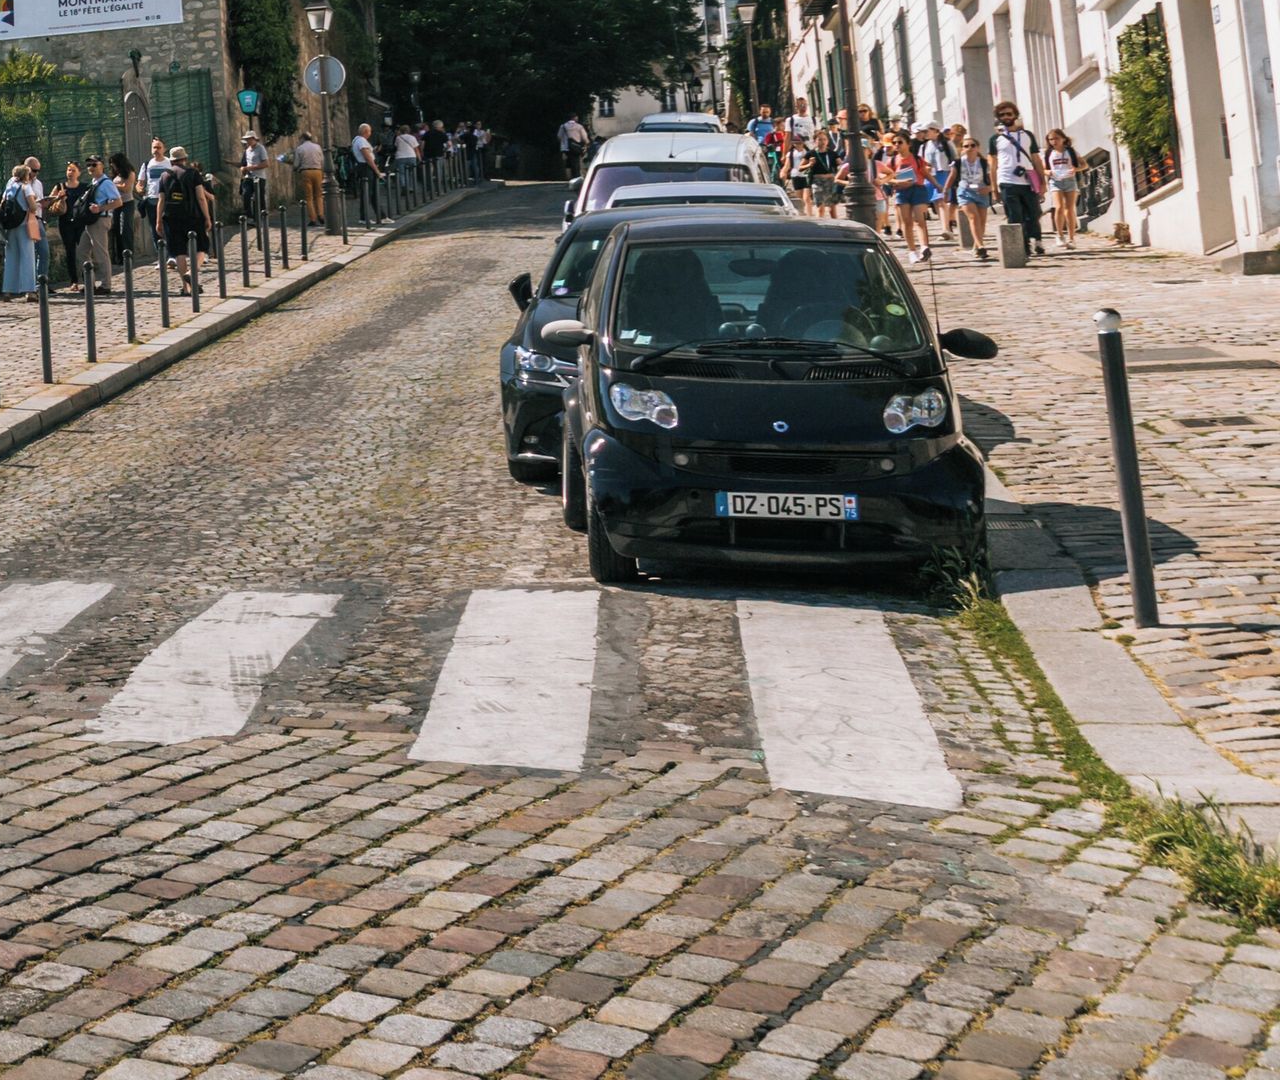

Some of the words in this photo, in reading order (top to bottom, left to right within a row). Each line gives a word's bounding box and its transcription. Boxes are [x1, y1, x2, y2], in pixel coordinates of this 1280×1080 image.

[59, 9, 68, 17] LE
[83, 5, 101, 15] FÊTE
[732, 494, 841, 517] DZ-045-PS
[845, 508, 857, 518] 75
